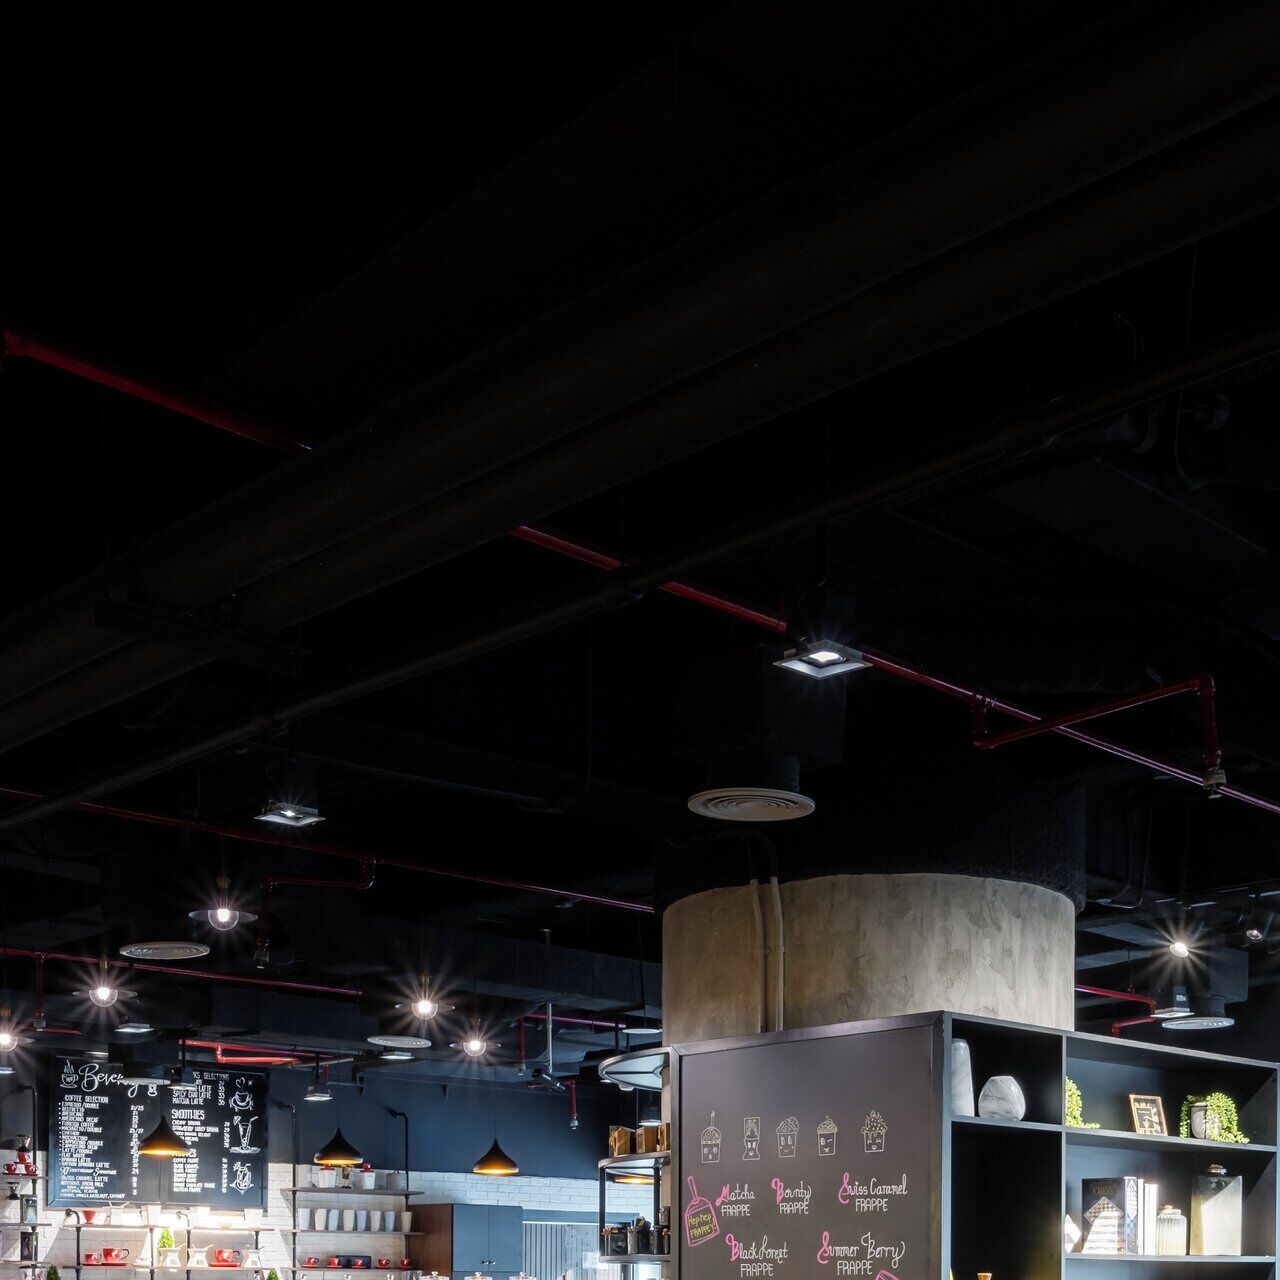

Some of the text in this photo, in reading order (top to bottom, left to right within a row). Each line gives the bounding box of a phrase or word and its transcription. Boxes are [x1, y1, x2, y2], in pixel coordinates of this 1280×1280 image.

[771, 1177, 812, 1206] Bounty
[870, 1172, 908, 1195] Caramel
[715, 1183, 756, 1206] Matcha
[721, 1204, 751, 1217] FRAPPE
[780, 1202, 809, 1215] FRAPPE
[855, 1198, 888, 1212] FRAPPE
[725, 1233, 760, 1261] Black
[860, 1231, 906, 1269] Berry
[740, 1263, 774, 1278] FRAPPE
[837, 1260, 873, 1276] FRAPPE
